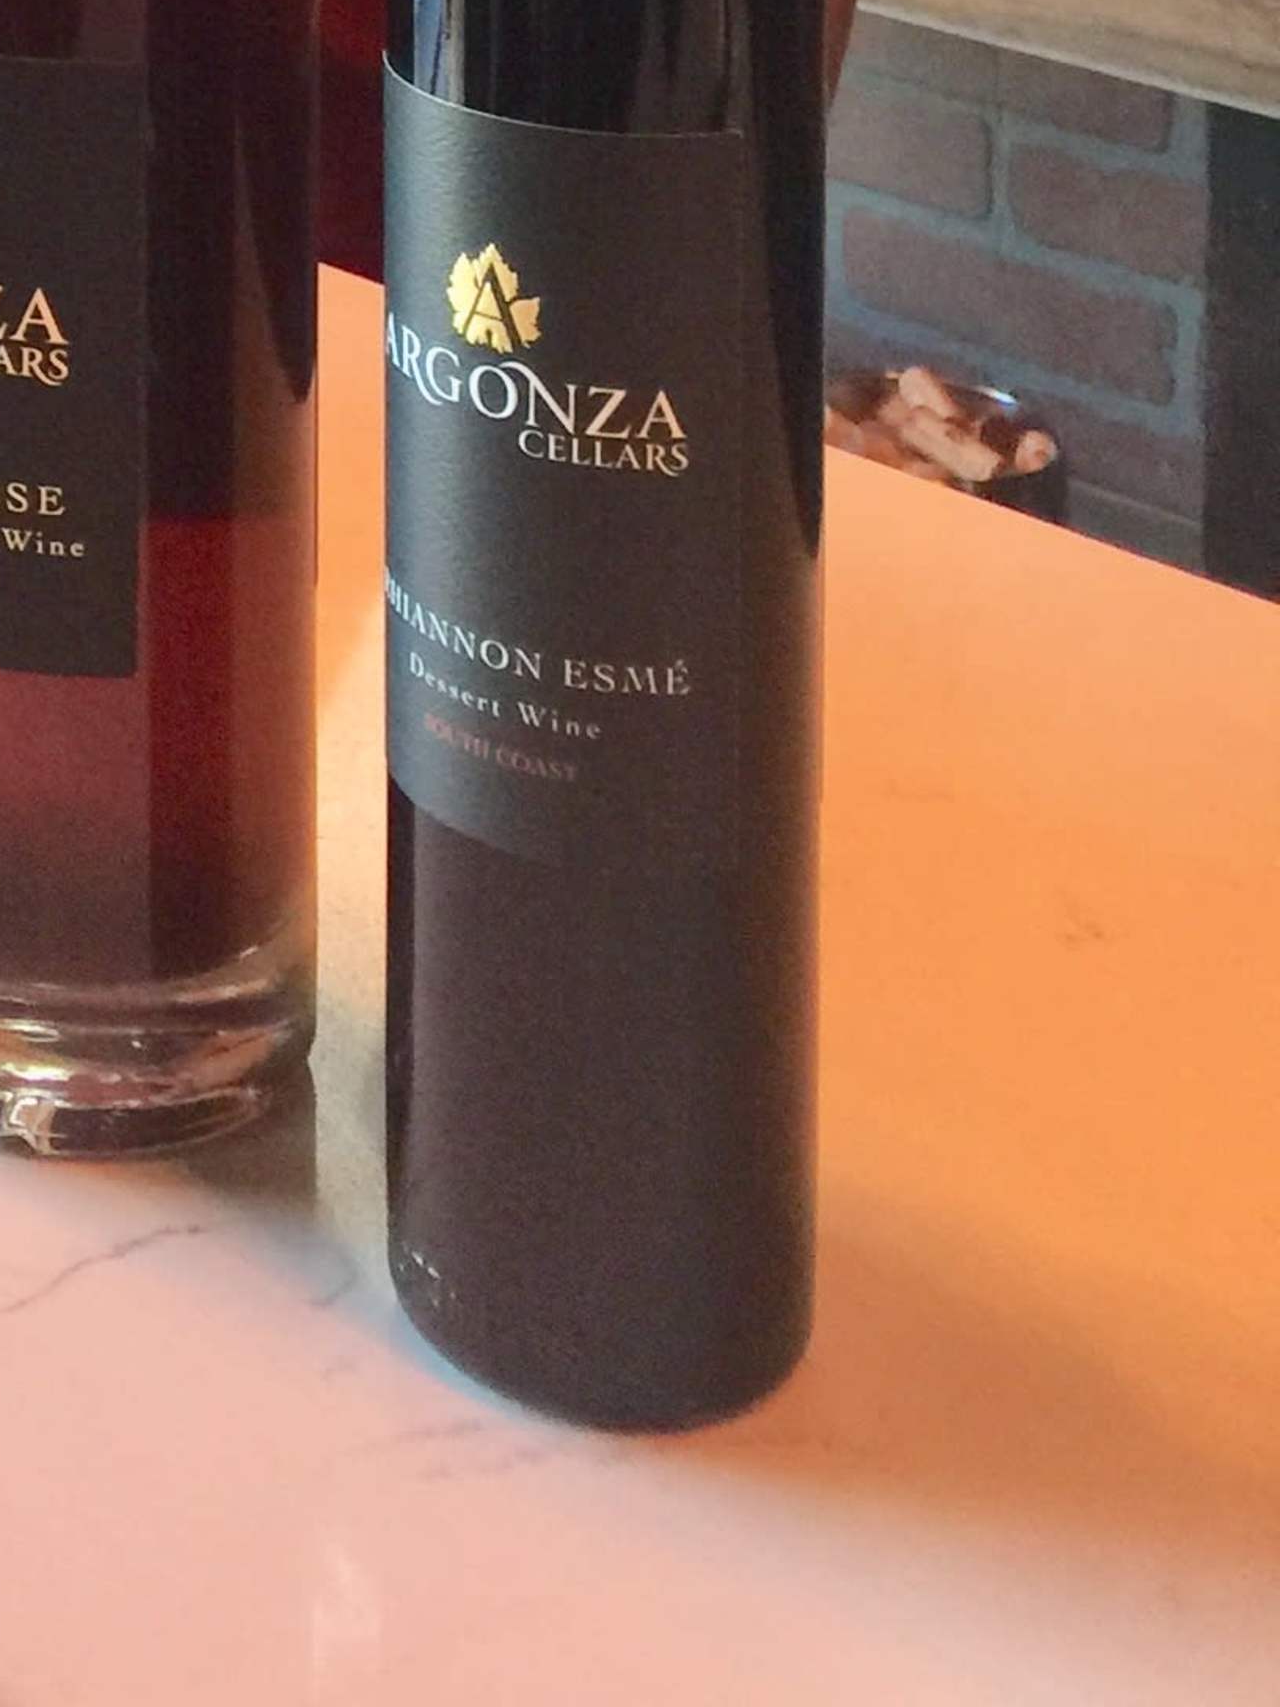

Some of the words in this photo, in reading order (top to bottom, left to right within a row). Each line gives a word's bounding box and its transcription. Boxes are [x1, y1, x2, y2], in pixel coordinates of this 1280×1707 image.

[518, 429, 689, 477] CELLARS
[1, 527, 85, 558] Wine
[409, 652, 502, 718] Dessert
[517, 700, 603, 740] Wine
[564, 658, 692, 696] ESMÉ
